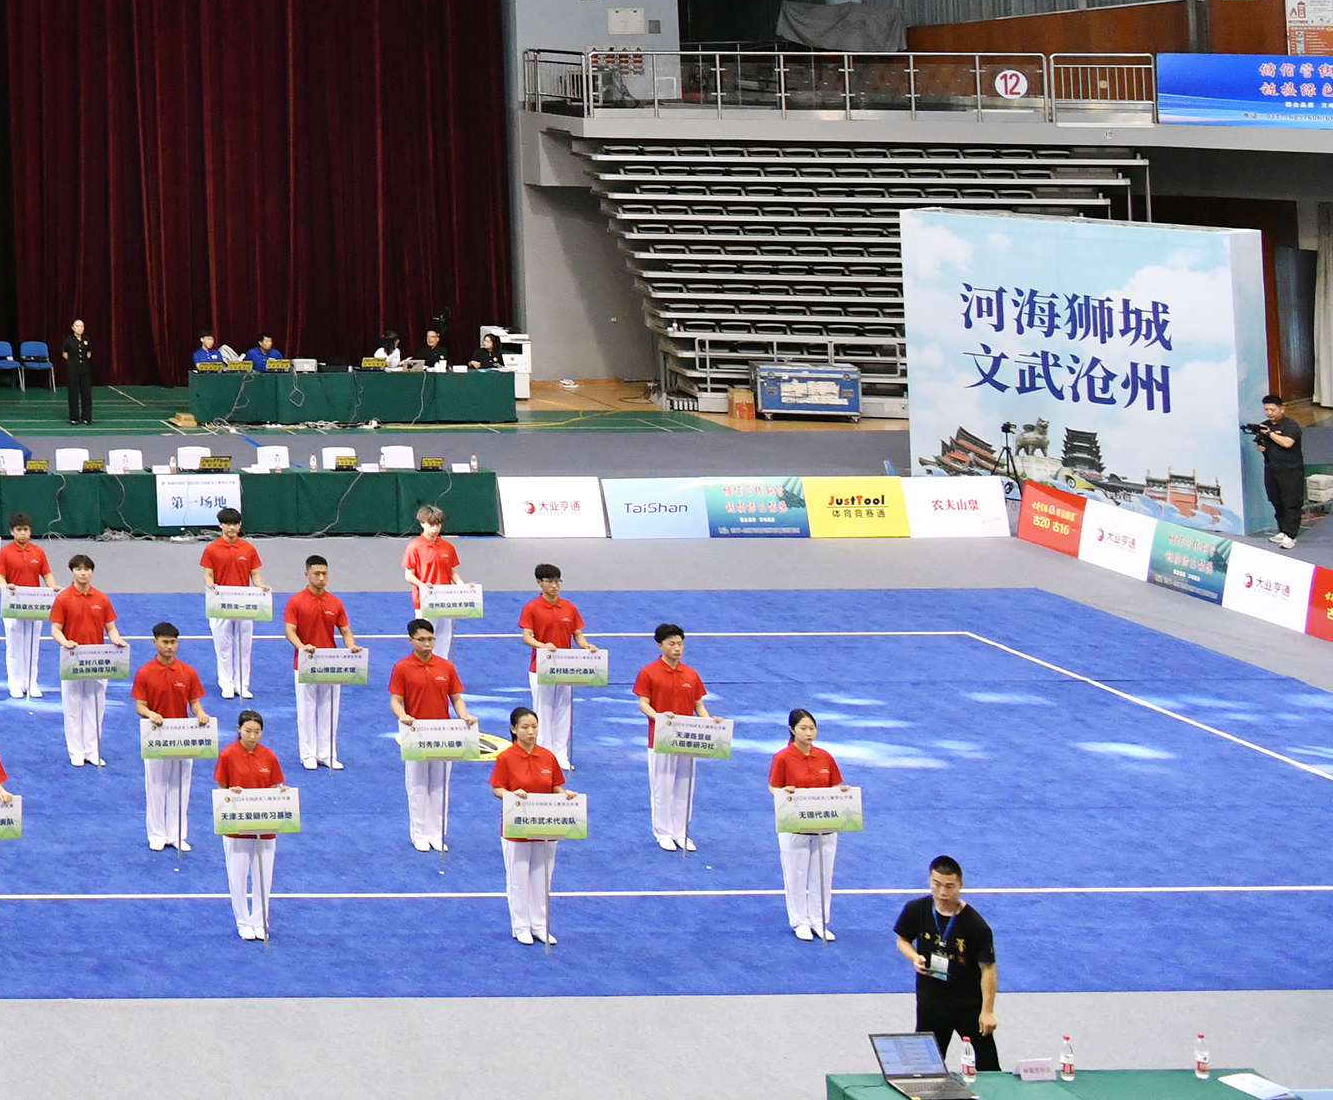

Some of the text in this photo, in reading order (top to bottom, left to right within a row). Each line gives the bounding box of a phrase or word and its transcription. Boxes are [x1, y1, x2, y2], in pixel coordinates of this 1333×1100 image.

[999, 74, 1022, 97] 12
[960, 282, 1173, 352] 河海狮城
[963, 343, 1172, 414] 文武沧州
[171, 495, 227, 509] 第一场地
[538, 501, 581, 512] 大业亨通
[624, 502, 688, 513] TaiShan
[828, 495, 885, 506] JustTool
[932, 499, 980, 511] 农夫山泉
[832, 509, 886, 518] 体育竞赛通
[1033, 515, 1070, 535] 古20 古16
[1106, 531, 1136, 550] 大业亨通
[1256, 578, 1291, 598] 大业亨通
[514, 817, 576, 825] 遵化市武术代表队
